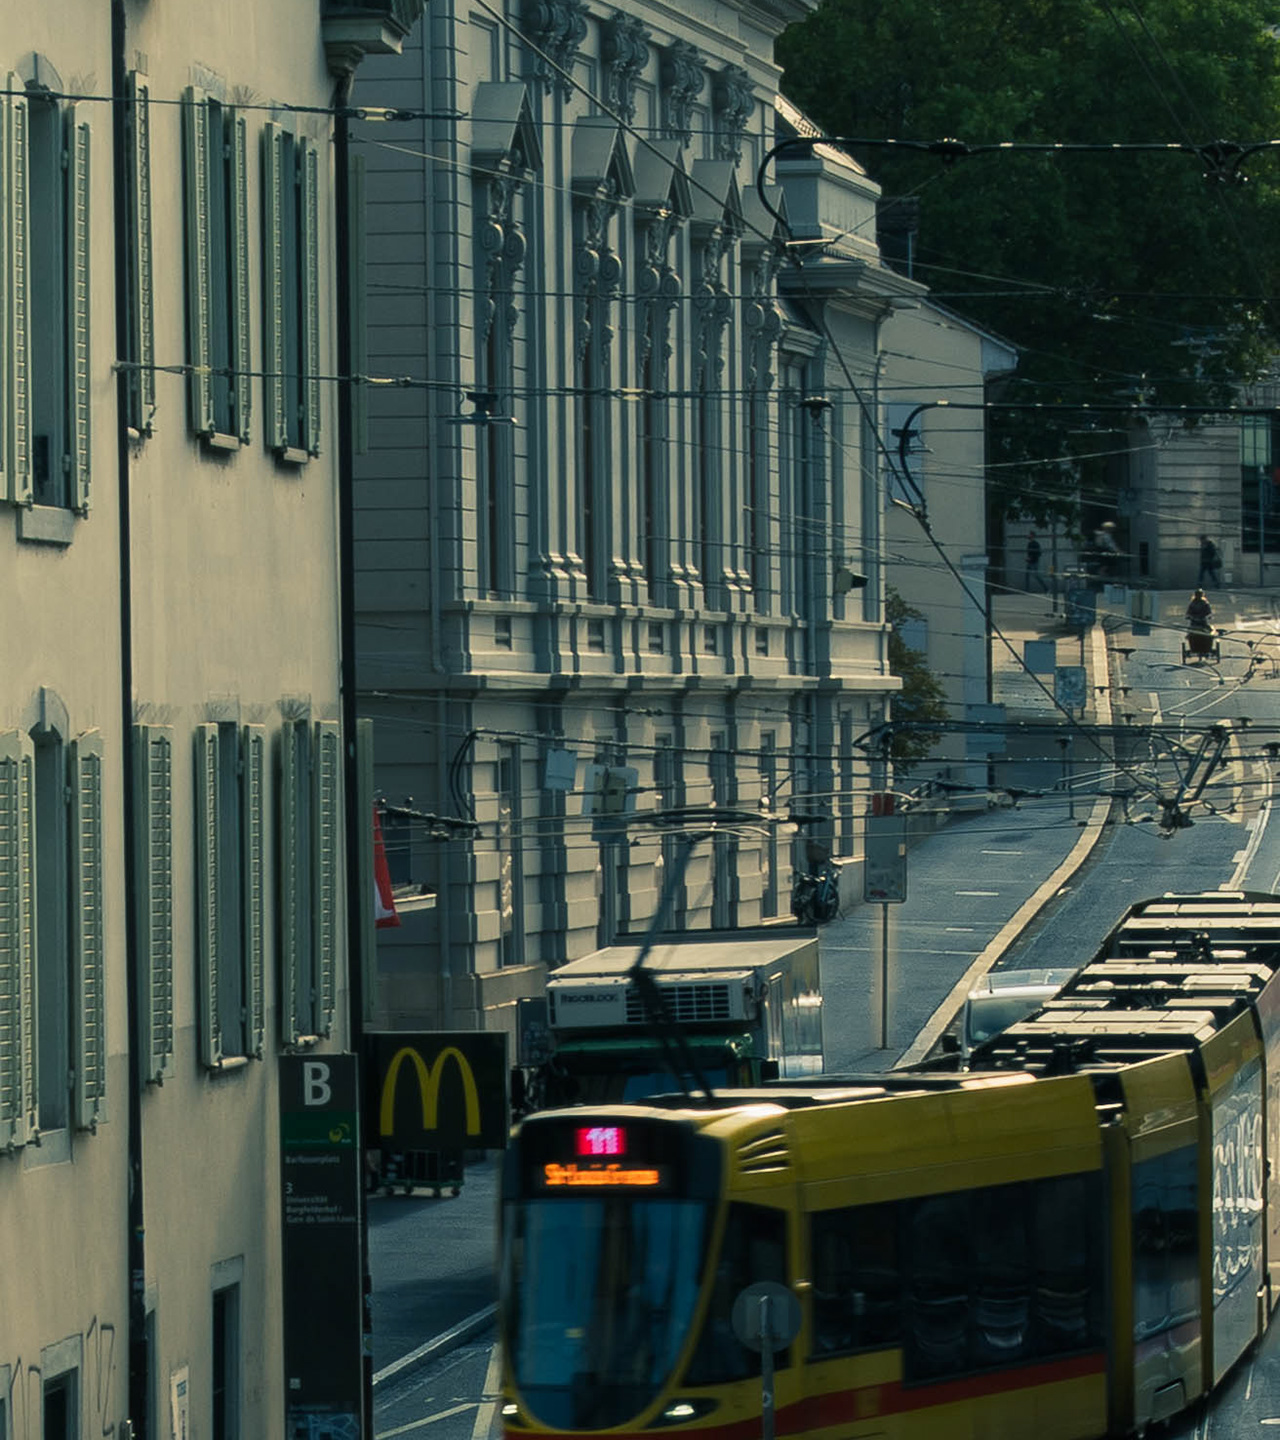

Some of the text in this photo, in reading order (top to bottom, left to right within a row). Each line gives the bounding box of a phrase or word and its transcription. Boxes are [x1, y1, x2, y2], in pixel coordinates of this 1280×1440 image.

[303, 1061, 331, 1106] B
[585, 1127, 618, 1154] 11
[285, 1181, 294, 1195] 3
